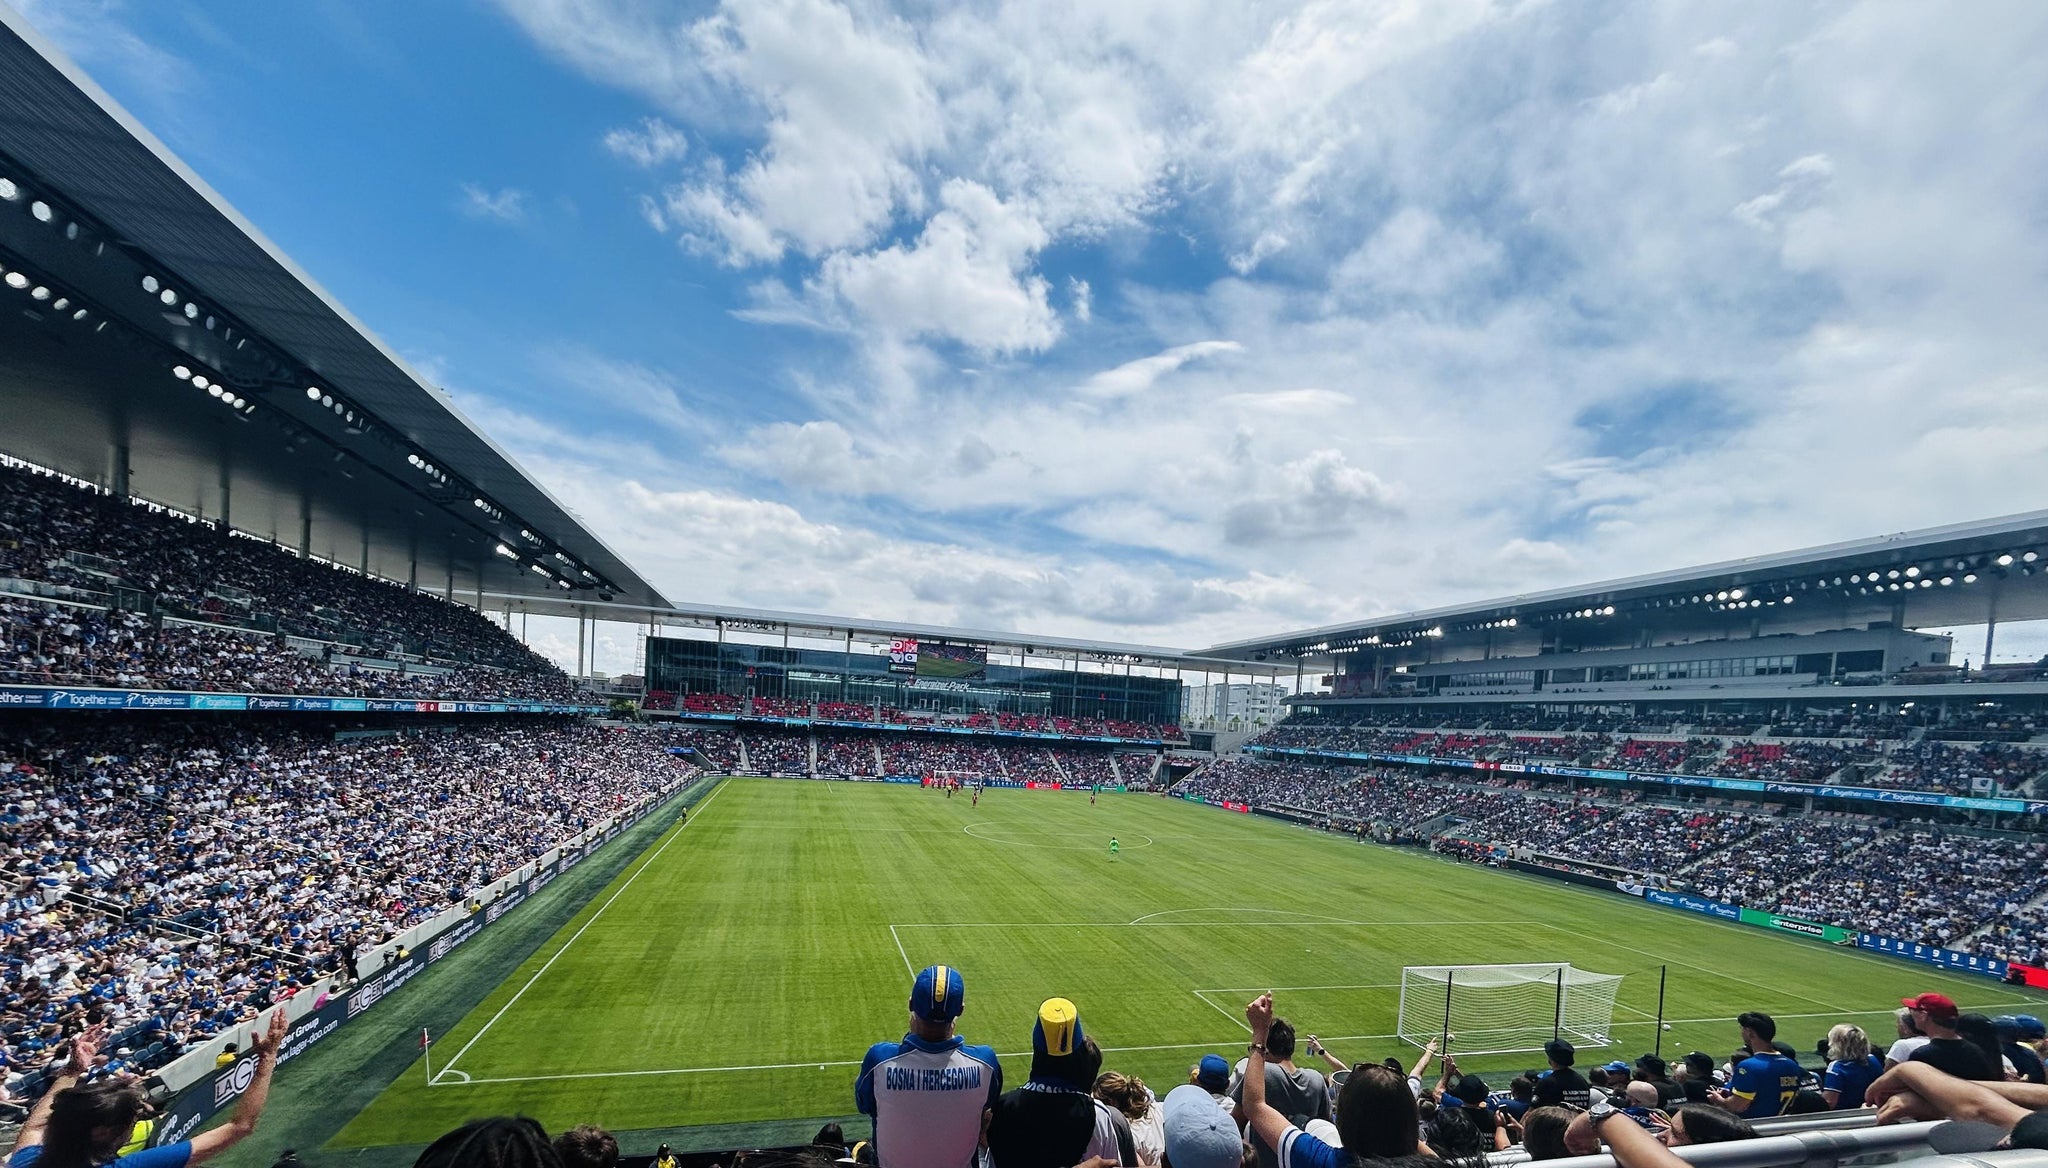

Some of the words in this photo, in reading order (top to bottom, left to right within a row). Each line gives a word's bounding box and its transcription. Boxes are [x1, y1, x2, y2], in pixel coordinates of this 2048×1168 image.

[914, 679, 949, 690] Energizer
[949, 682, 970, 690] Park
[69, 694, 108, 706] Together
[141, 695, 172, 706] Together
[1778, 784, 1804, 793] Together
[1833, 790, 1862, 799] Together
[1892, 792, 1924, 802] Together
[1772, 919, 1822, 935] enterprise
[384, 969, 398, 982] Lager
[398, 959, 414, 972] Group
[348, 981, 383, 1012] LAGER
[295, 1018, 319, 1038] Group
[886, 1067, 915, 1091] BOSNA
[917, 1068, 920, 1090] I
[922, 1066, 981, 1091] HERCEGOVINA
[1779, 1090, 1796, 1116] 7
